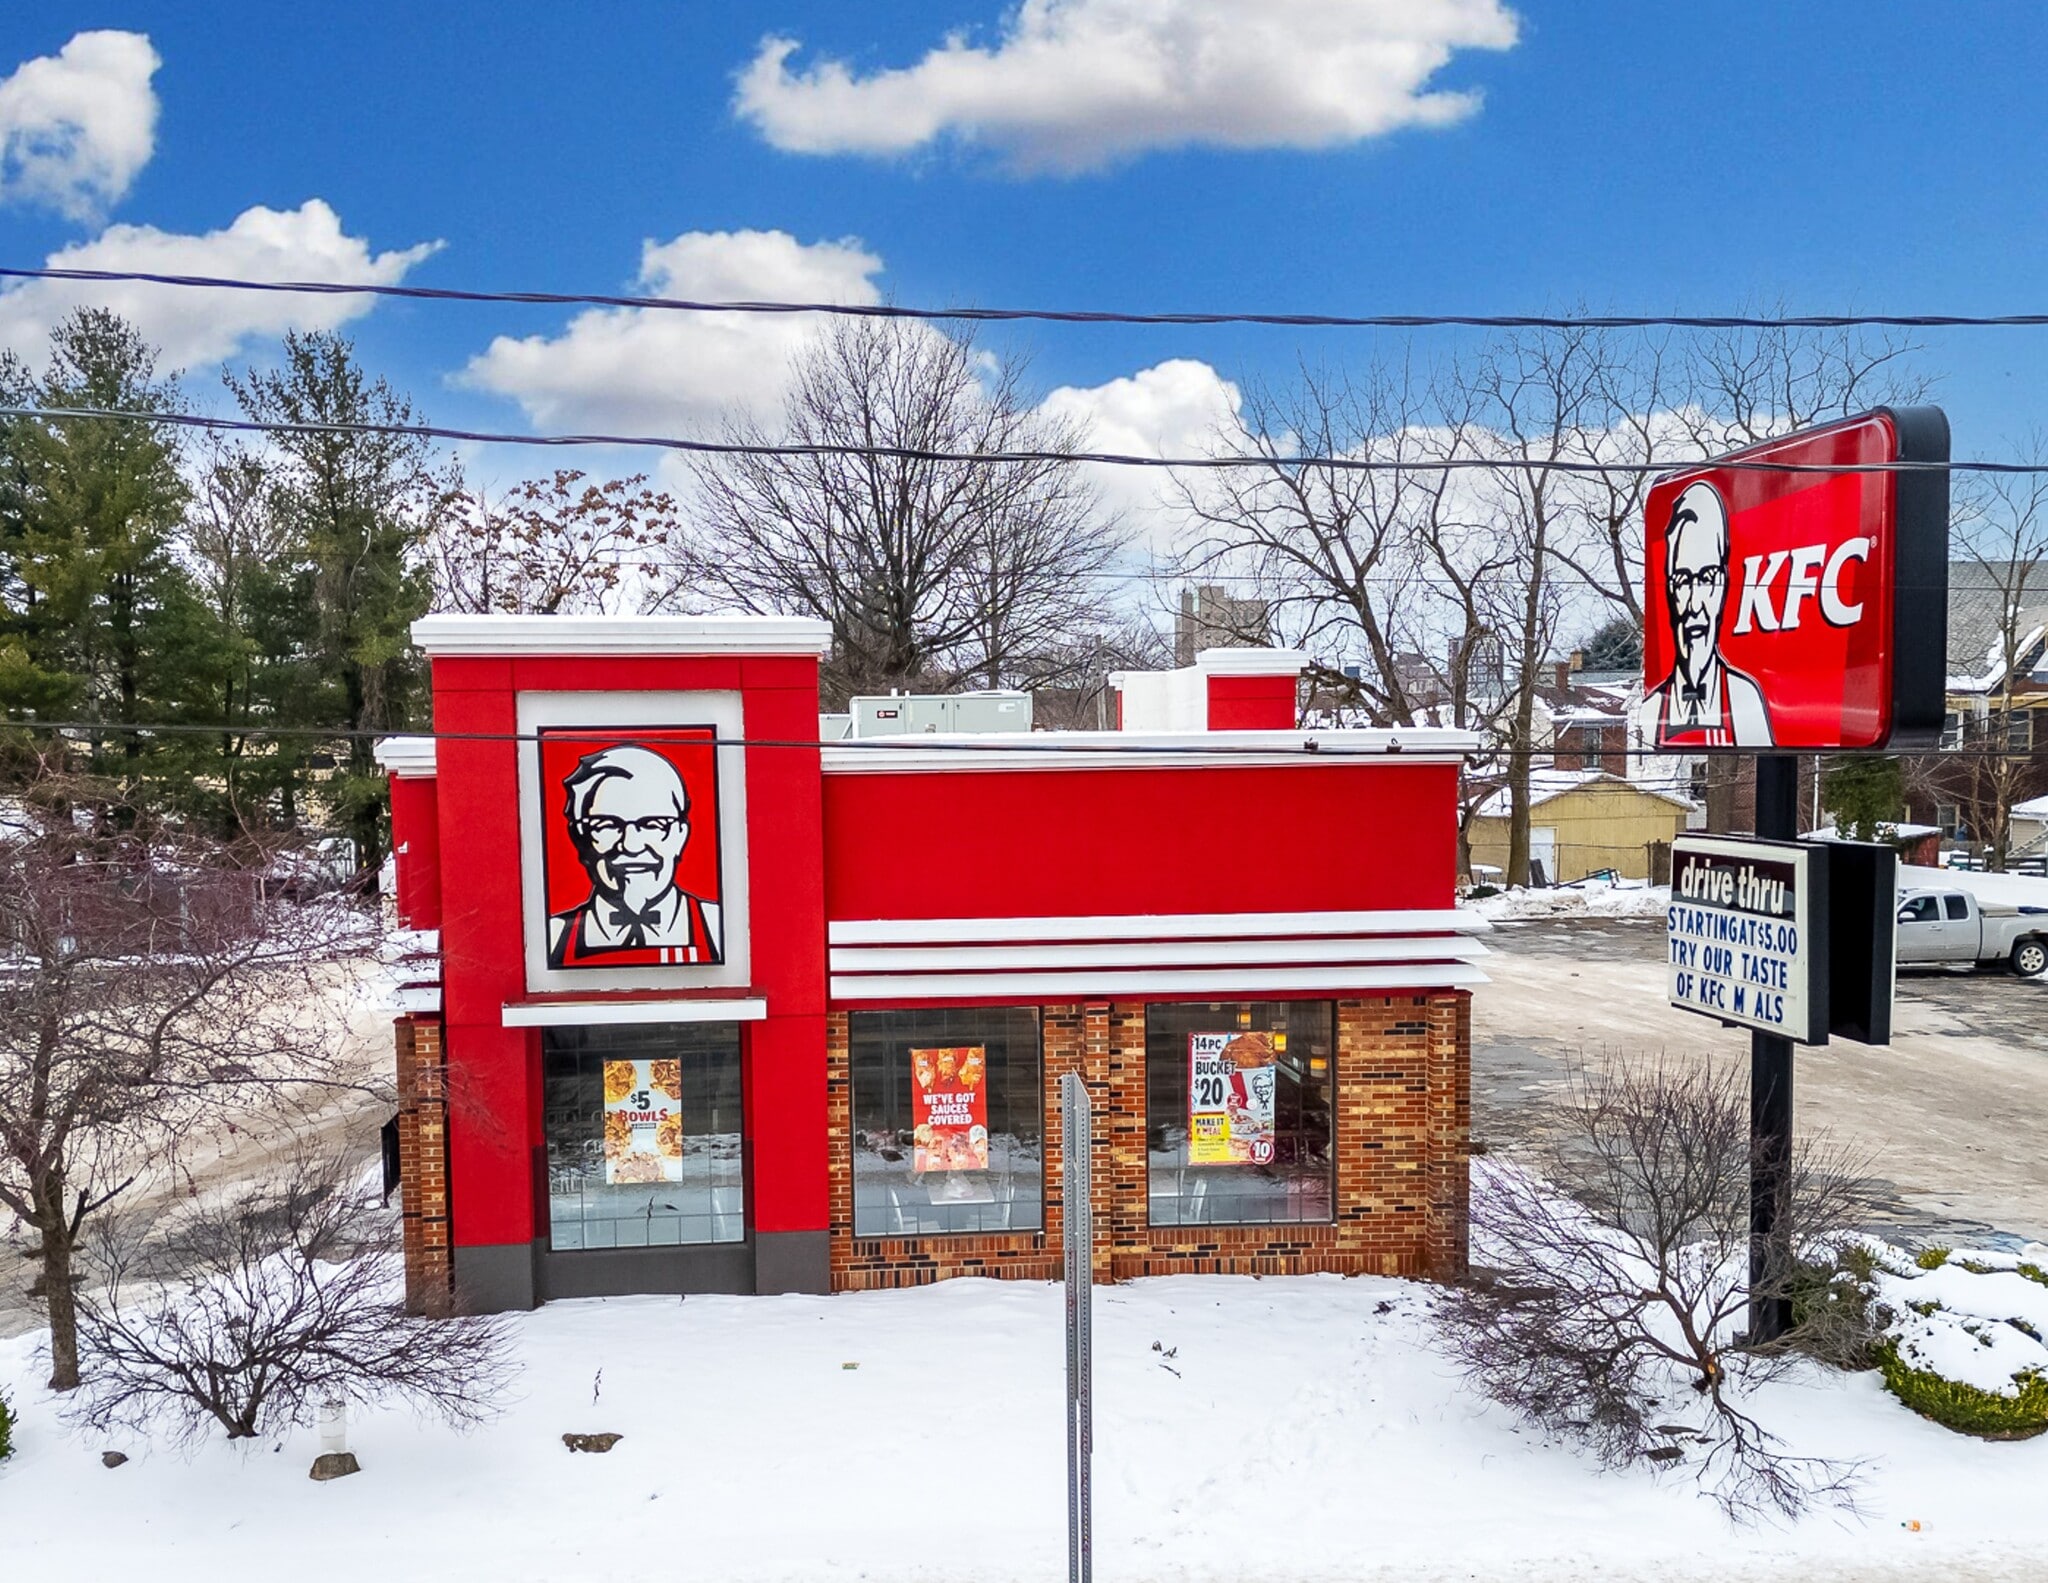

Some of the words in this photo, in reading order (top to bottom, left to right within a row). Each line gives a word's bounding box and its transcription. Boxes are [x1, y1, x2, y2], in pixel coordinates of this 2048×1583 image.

[1732, 536, 1870, 636] KFC
[1681, 856, 1733, 904] drive
[1738, 865, 1784, 914] thru
[1671, 938, 1697, 967] TRY
[1703, 945, 1732, 976] OUR
[1742, 953, 1787, 989] TASTE
[1677, 972, 1693, 998] OF
[1700, 977, 1726, 1009] KFC
[1196, 1061, 1236, 1075] BUCKET
[630, 1090, 650, 1110] $5
[923, 1093, 954, 1105] WE'VE
[955, 1092, 976, 1104] GOT
[1194, 1078, 1223, 1105] $20
[618, 1108, 668, 1122] BOWLS
[931, 1104, 969, 1115] SAUCES
[928, 1114, 973, 1125] COVERED
[1196, 1118, 1215, 1126] MAKE
[1217, 1118, 1224, 1126] IT
